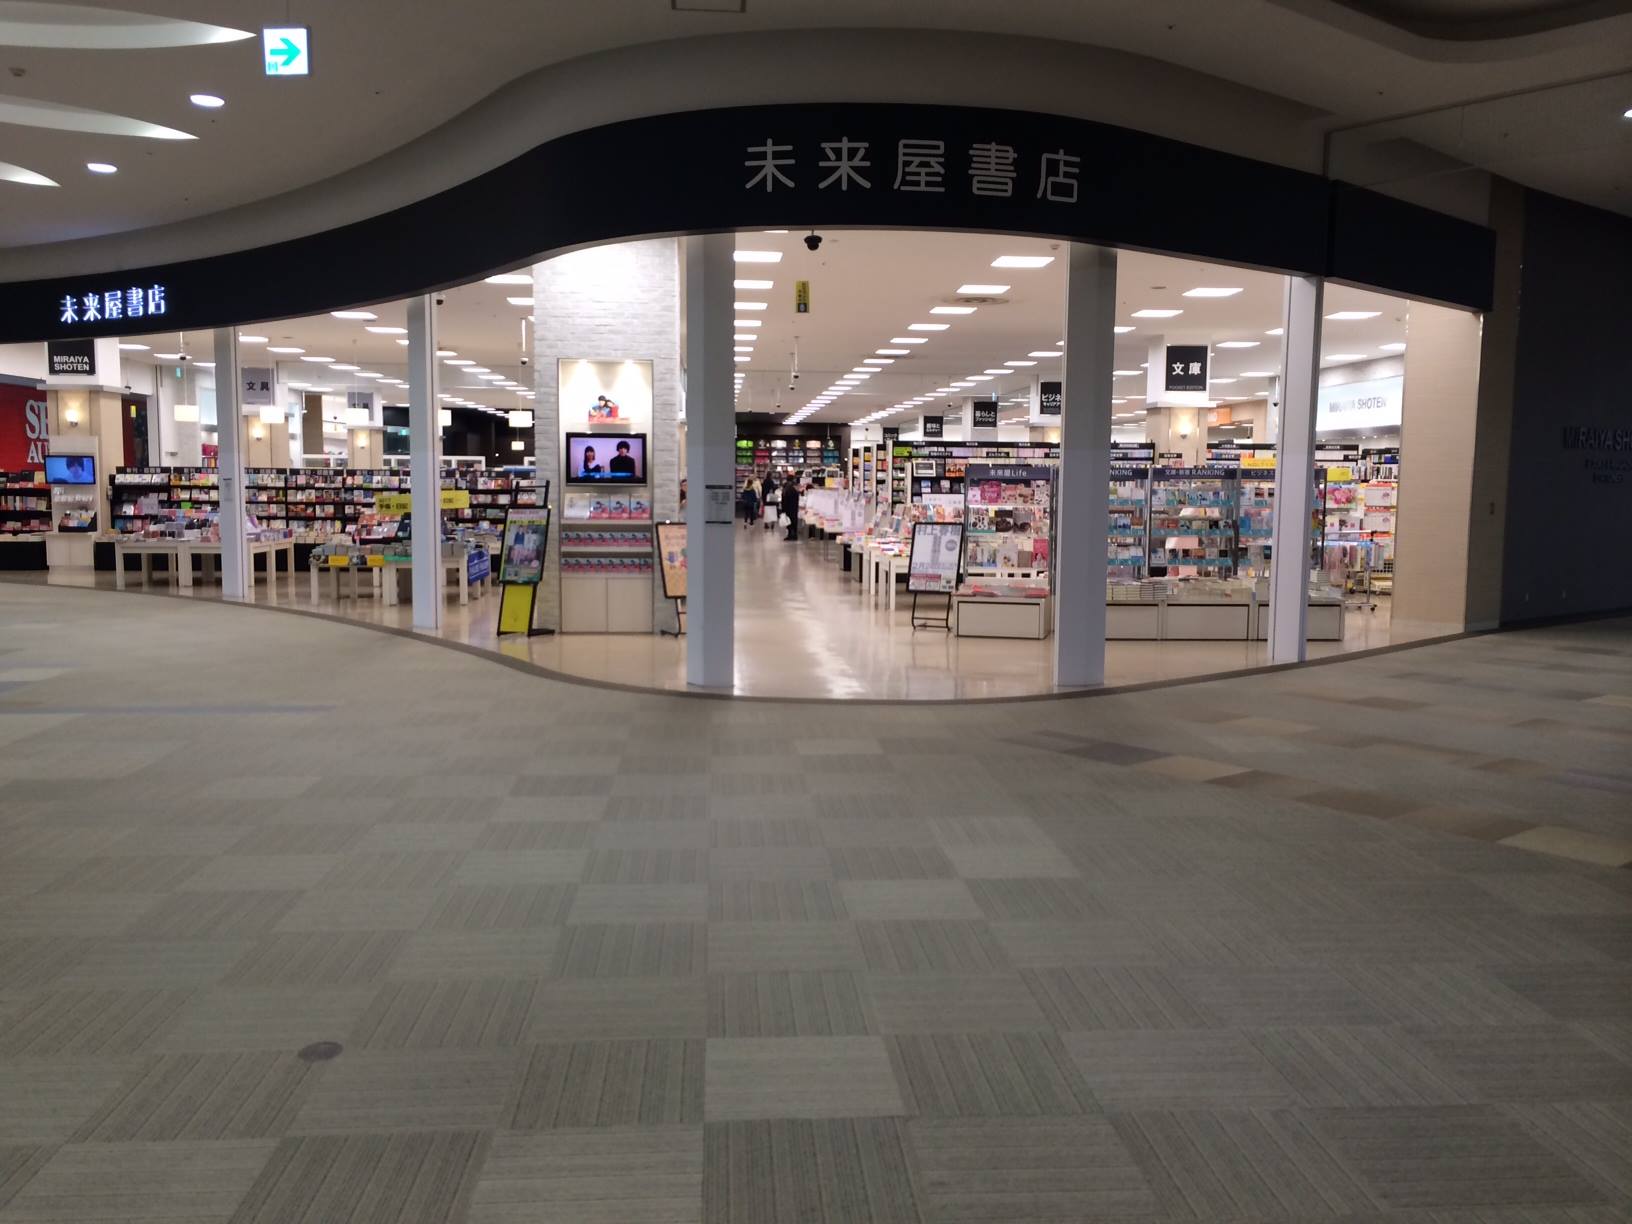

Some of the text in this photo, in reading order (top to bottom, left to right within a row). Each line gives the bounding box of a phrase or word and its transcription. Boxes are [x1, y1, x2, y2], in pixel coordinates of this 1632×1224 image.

[744, 136, 1082, 203] 未来屋書店
[60, 284, 167, 324] 未来屋書店
[53, 355, 89, 363] MIRAIYA
[54, 363, 90, 371] SHOTEN
[1171, 361, 1202, 376] 文庫
[246, 381, 270, 391] 文具
[1615, 428, 1632, 451] SH
